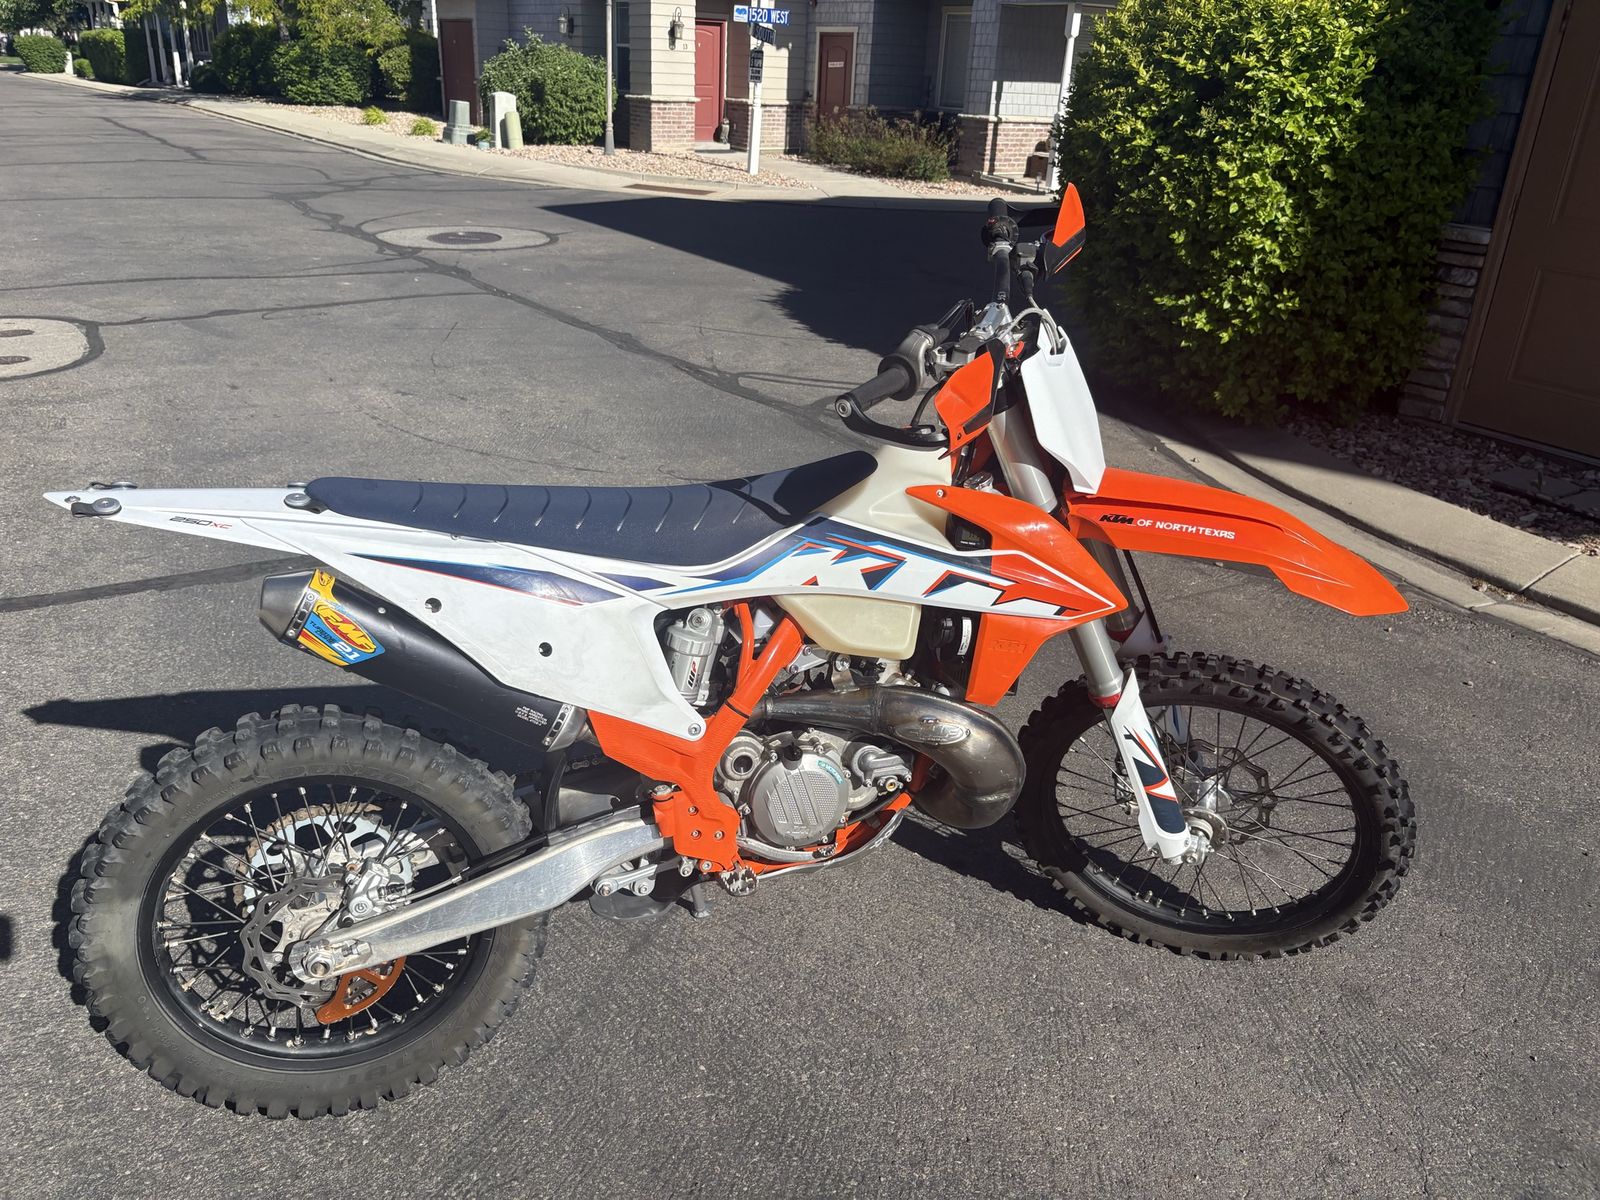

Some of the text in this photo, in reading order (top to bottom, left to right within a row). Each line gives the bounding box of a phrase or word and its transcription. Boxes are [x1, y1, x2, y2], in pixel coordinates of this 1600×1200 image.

[749, 8, 768, 23] 1520
[770, 10, 789, 24] WEST
[1099, 513, 1236, 540] KTM OF NORTH TEXAS
